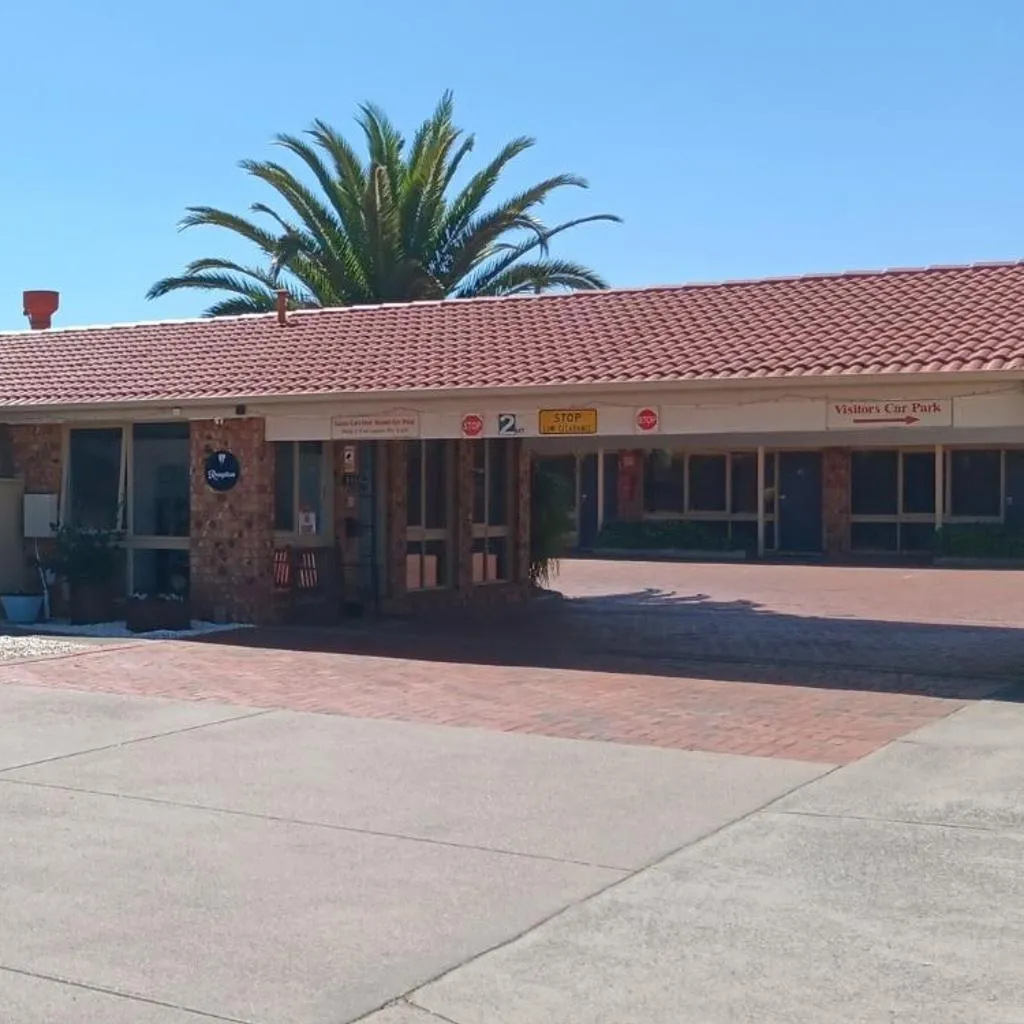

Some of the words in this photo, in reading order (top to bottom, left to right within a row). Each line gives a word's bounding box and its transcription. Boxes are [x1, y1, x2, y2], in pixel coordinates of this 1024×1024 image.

[834, 404, 881, 414] Visitors
[884, 403, 908, 413] Car
[912, 402, 942, 413] Park
[554, 412, 582, 423] STOP
[499, 414, 516, 435] 2
